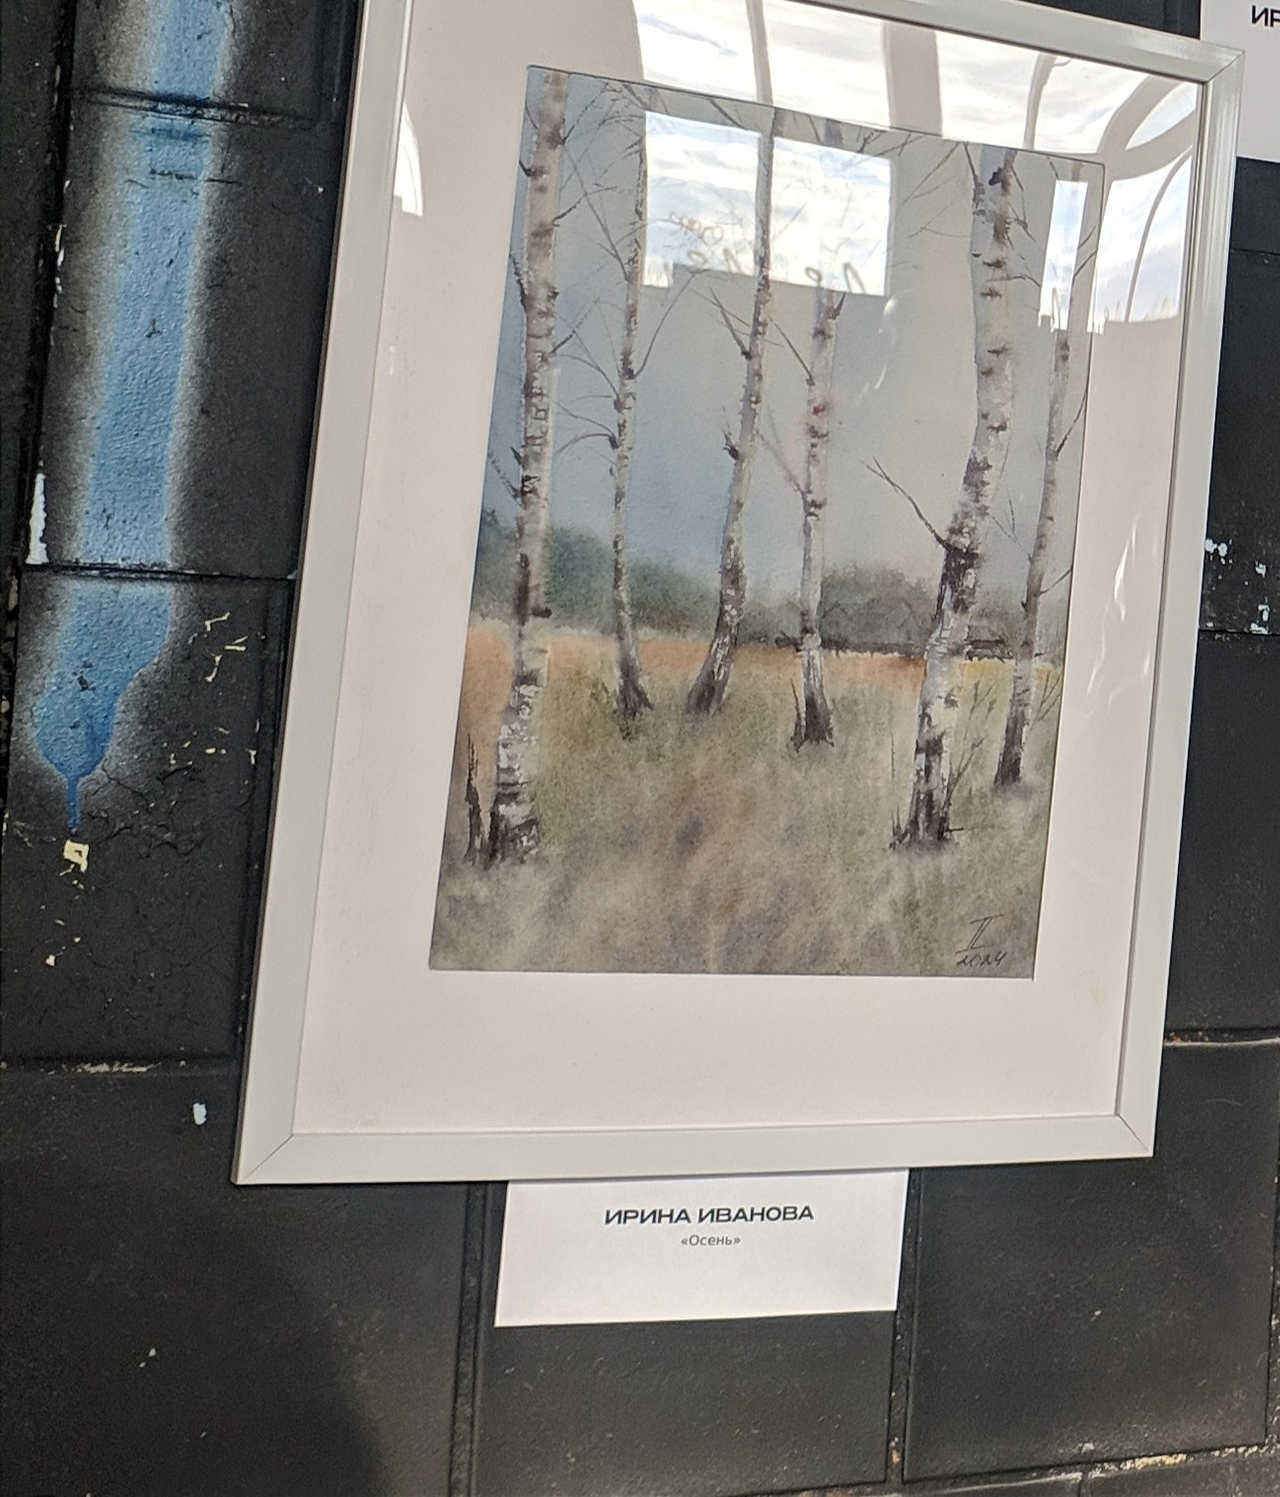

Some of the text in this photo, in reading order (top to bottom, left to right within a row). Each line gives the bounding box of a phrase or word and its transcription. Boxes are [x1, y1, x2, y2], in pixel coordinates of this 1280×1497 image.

[605, 1205, 814, 1225] ИРИНА ИВАНОВА
[681, 1234, 741, 1246] «Осень»
